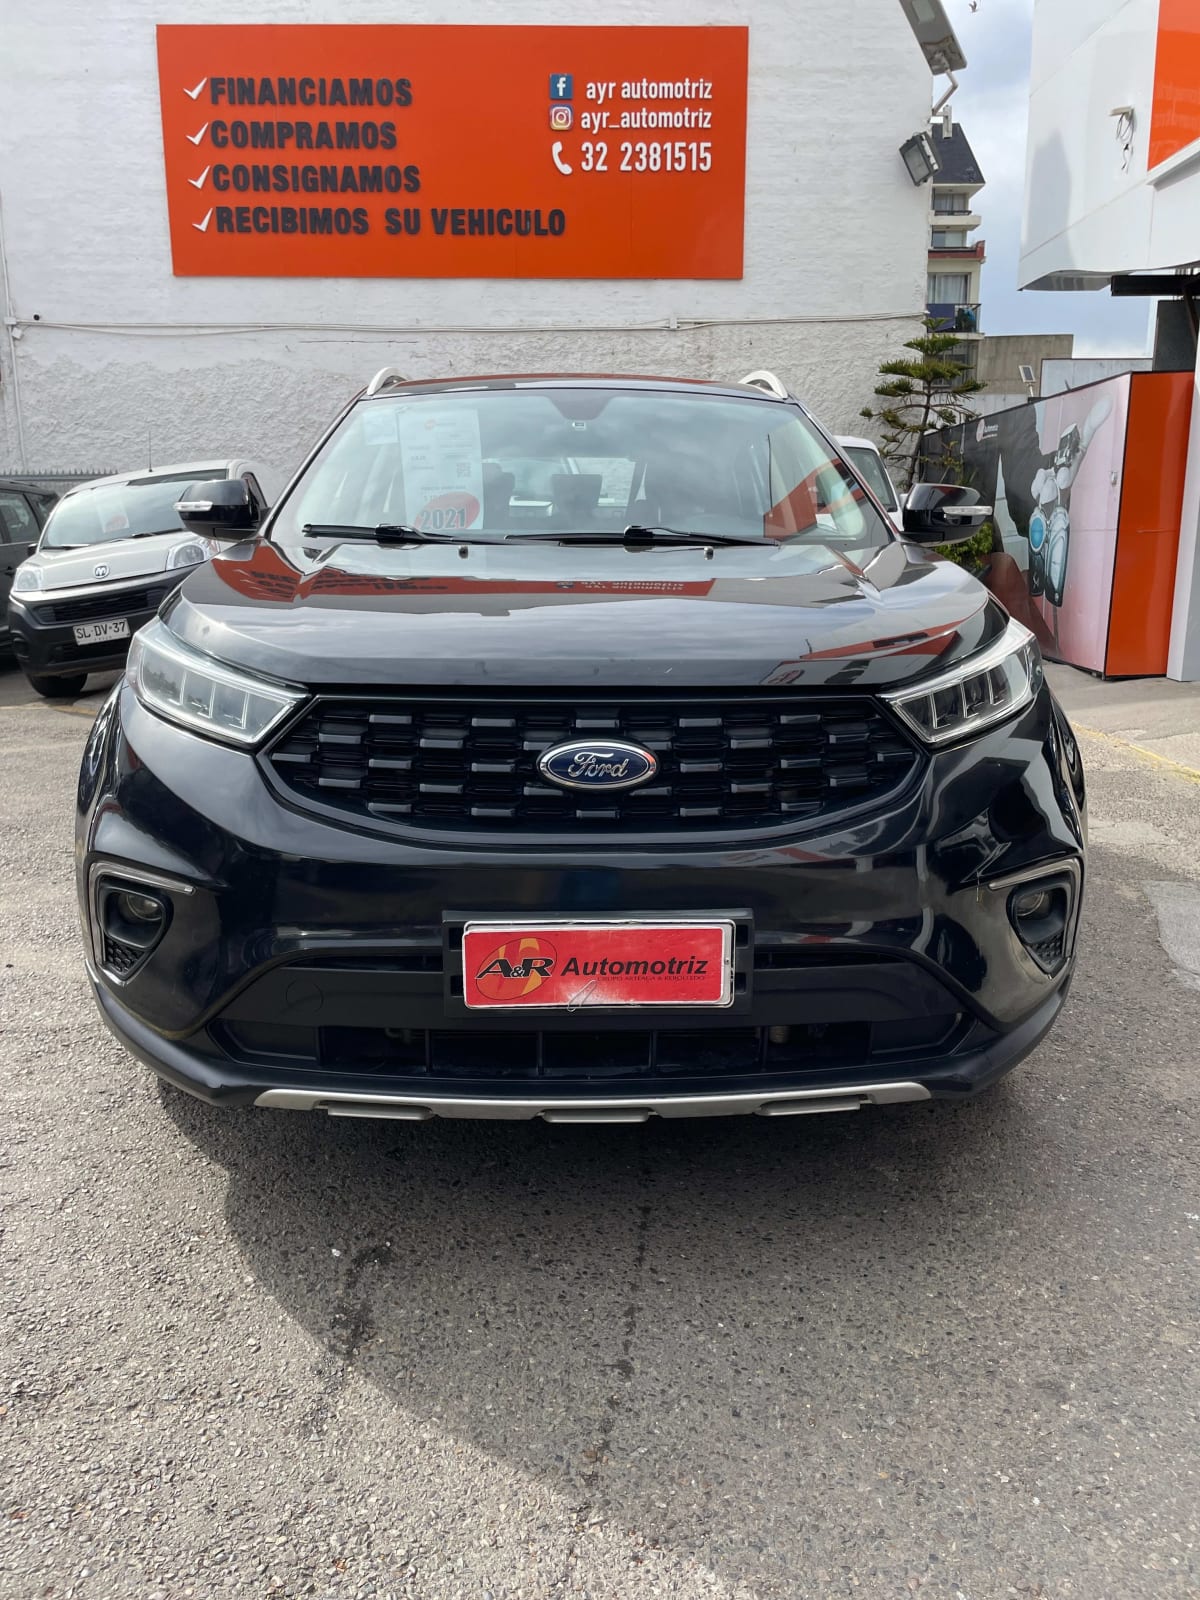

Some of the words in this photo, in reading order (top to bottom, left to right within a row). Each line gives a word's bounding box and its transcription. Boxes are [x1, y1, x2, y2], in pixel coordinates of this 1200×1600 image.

[209, 77, 413, 106] FINANCIAMOS
[586, 80, 617, 103] ayr
[621, 77, 712, 100] automotriz
[580, 106, 712, 133] ayr_automotriz
[210, 120, 398, 150] COMPRAMOS
[580, 141, 609, 172] 32
[620, 141, 713, 172] 2381515
[212, 164, 421, 193] CONSIGNAMOS
[215, 206, 369, 235] RECIBIMOS
[384, 207, 421, 235] SU
[432, 208, 566, 237] VEHICULO
[420, 508, 466, 530] 2021
[567, 751, 629, 778] Ford
[475, 957, 555, 979] A&R
[560, 956, 708, 977] Automotriz
